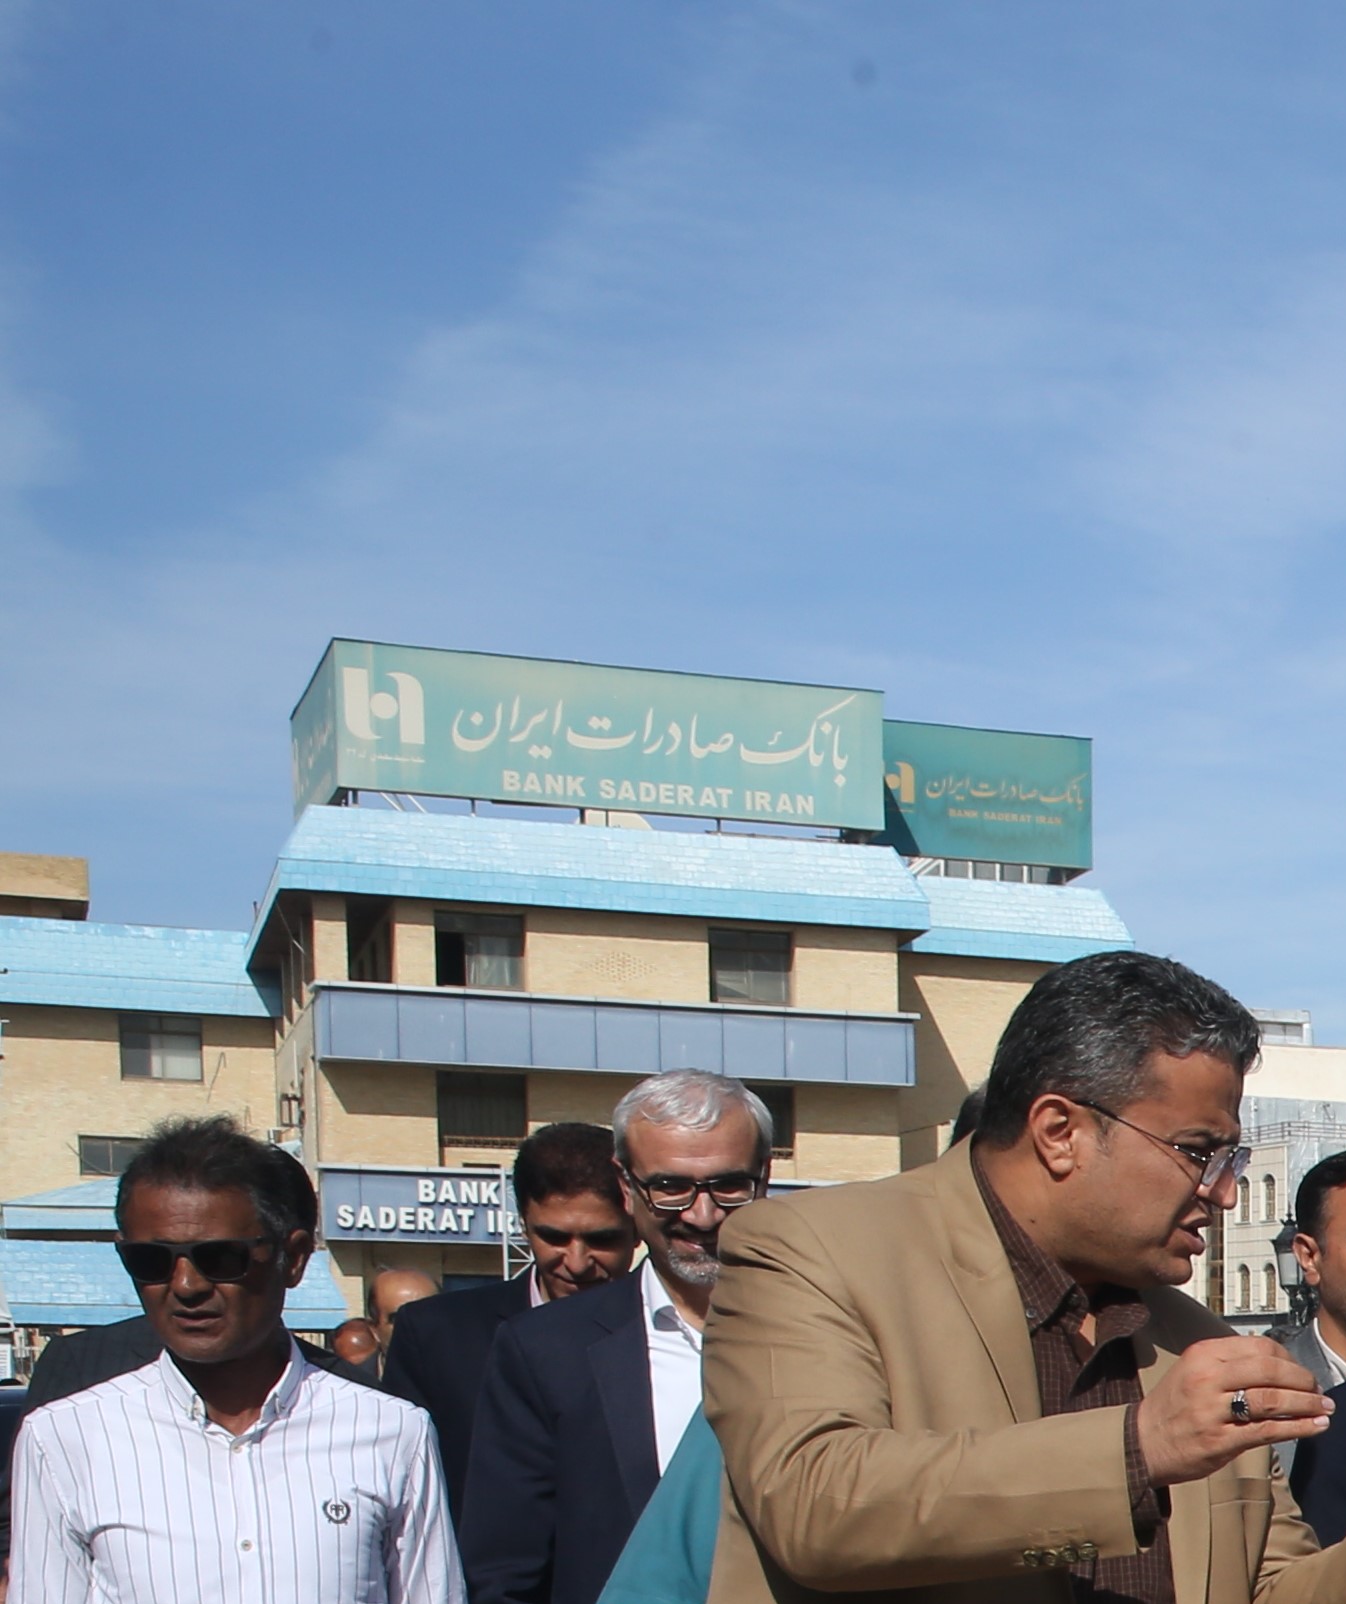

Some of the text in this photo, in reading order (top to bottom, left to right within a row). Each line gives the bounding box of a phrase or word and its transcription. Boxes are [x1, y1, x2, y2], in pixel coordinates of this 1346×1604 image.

[452, 694, 857, 787] بانک صادرات ایران
[502, 768, 815, 816] BANK SADERAT IRAN
[925, 772, 1088, 812] بانک صادرات ایران
[948, 807, 1063, 825] BANK SADERAT IRAN
[417, 1179, 501, 1206] BANK
[336, 1204, 475, 1233] SADERAT
